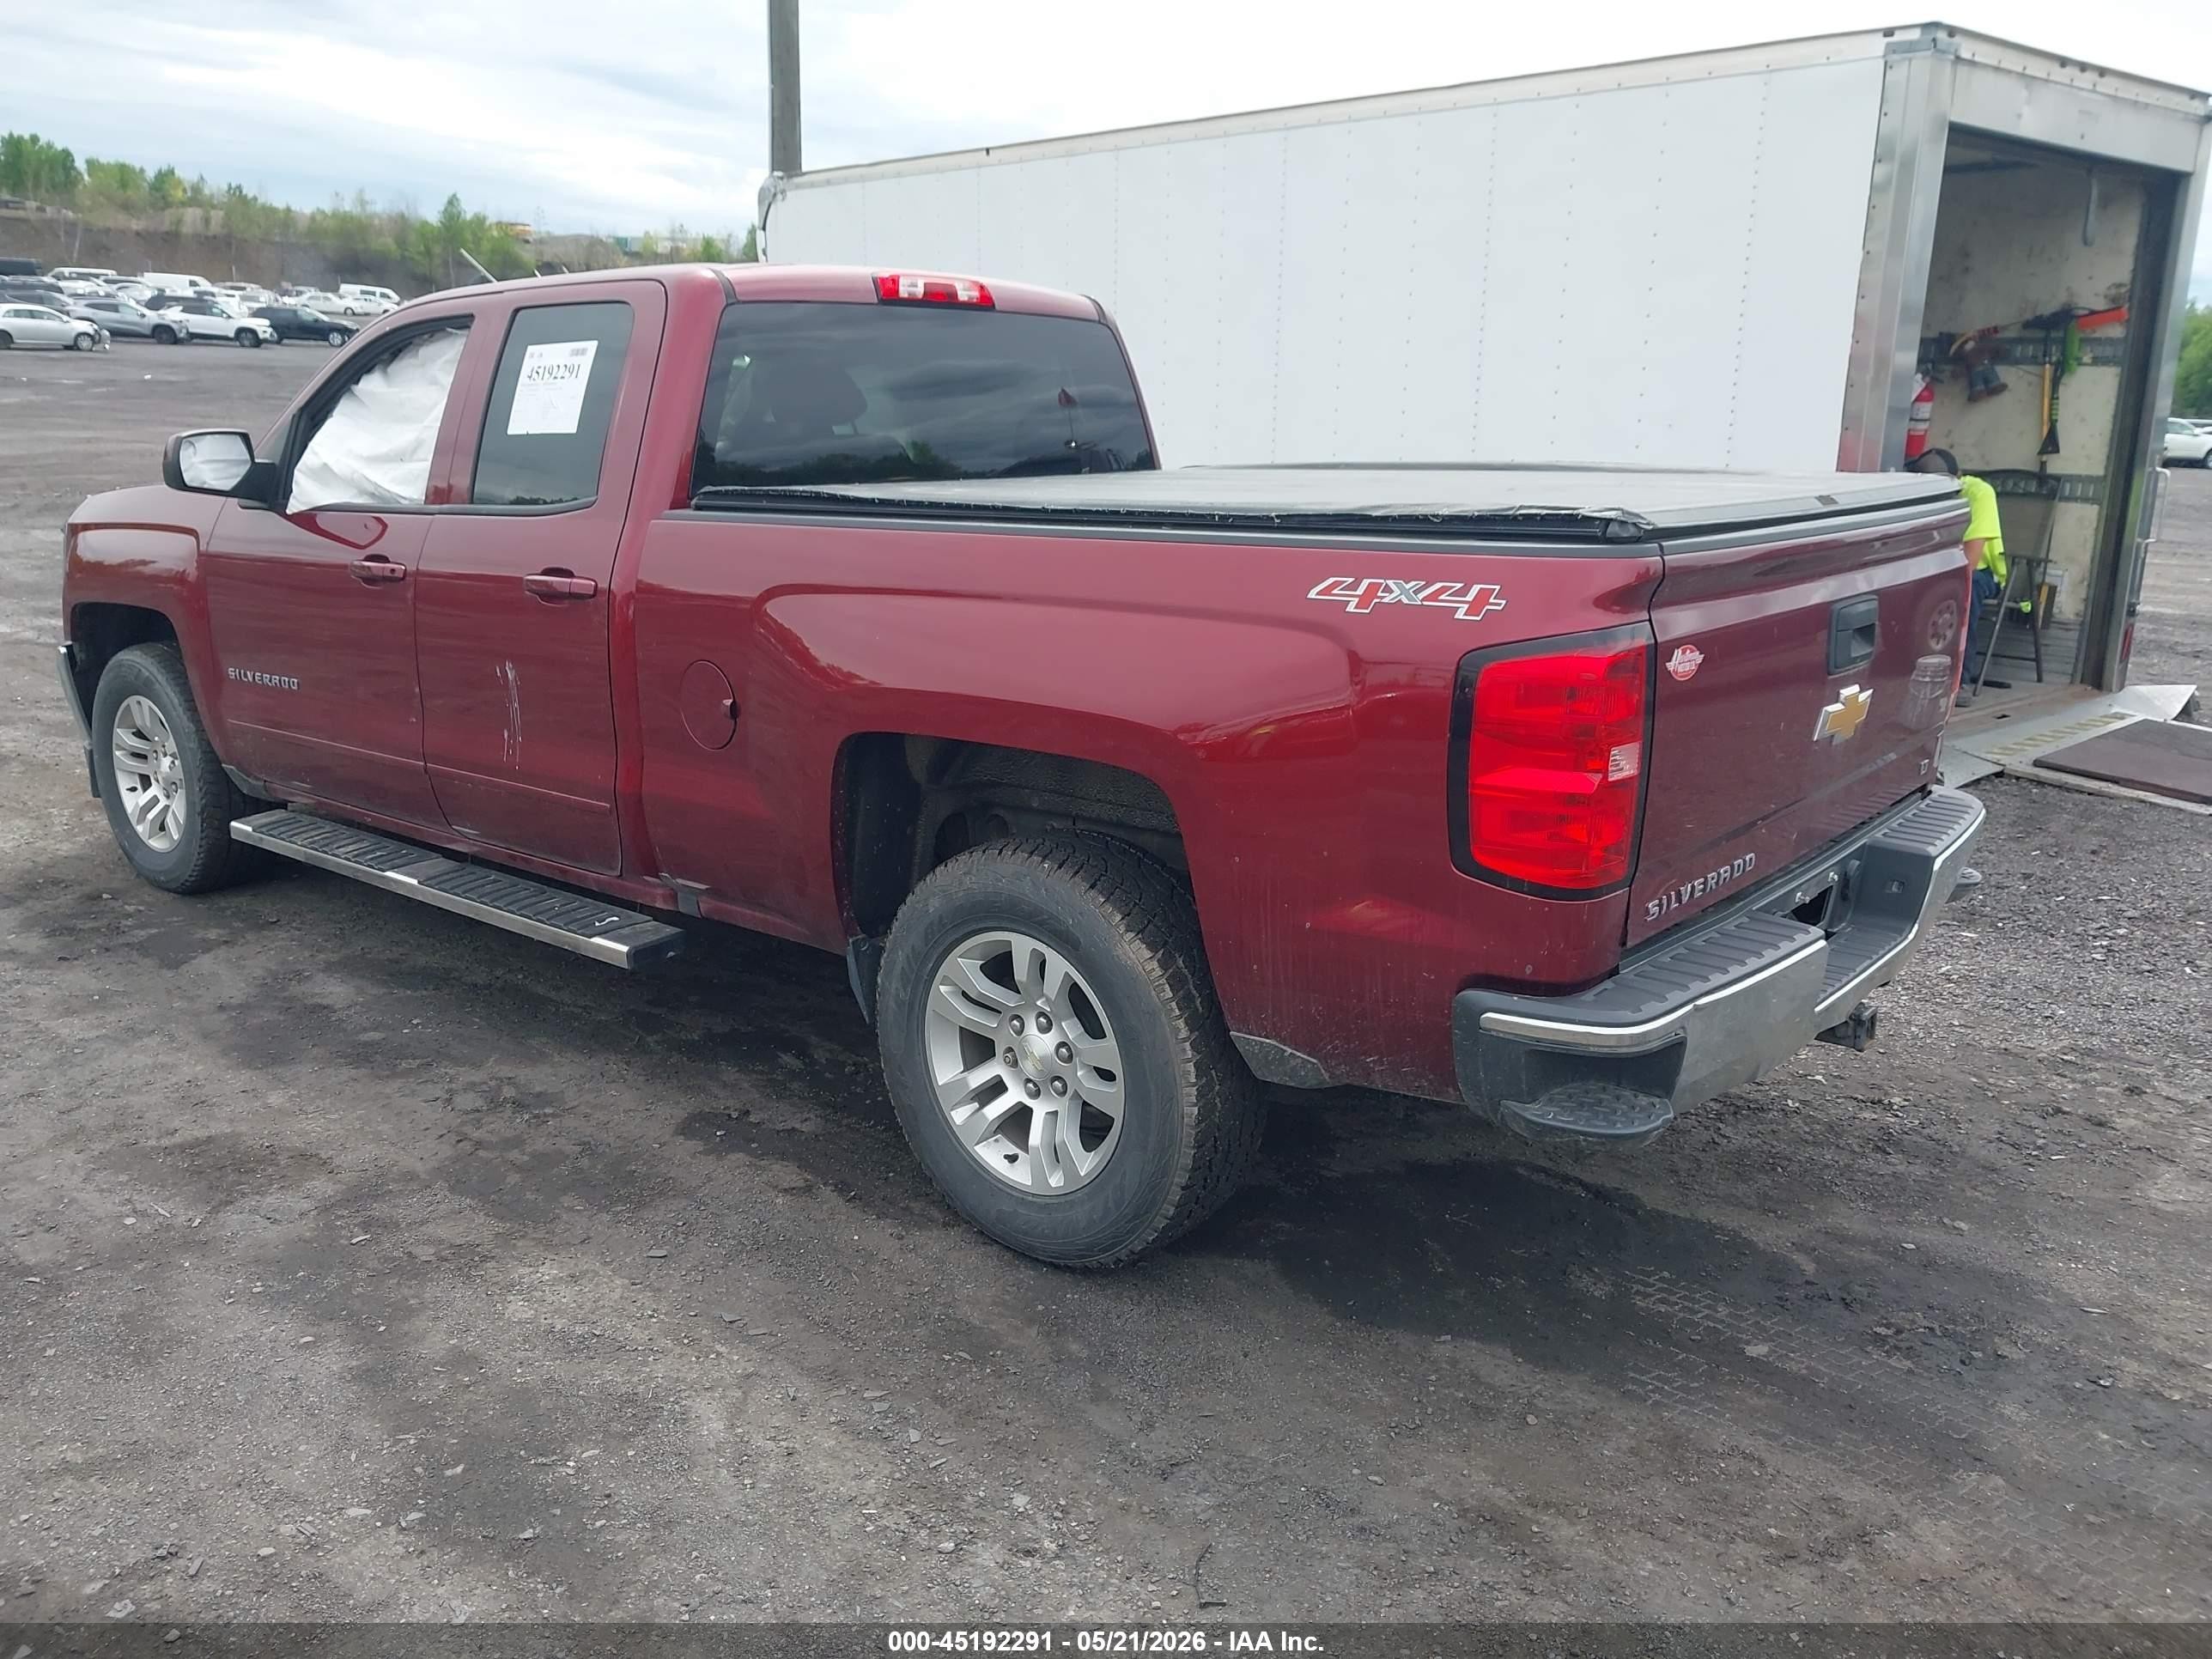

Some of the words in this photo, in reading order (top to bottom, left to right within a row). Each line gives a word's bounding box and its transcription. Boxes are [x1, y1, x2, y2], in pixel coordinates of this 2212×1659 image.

[527, 363, 580, 381] 45192291
[228, 667, 298, 690] SILVERADO
[1644, 853, 1756, 921] SILVERADO
